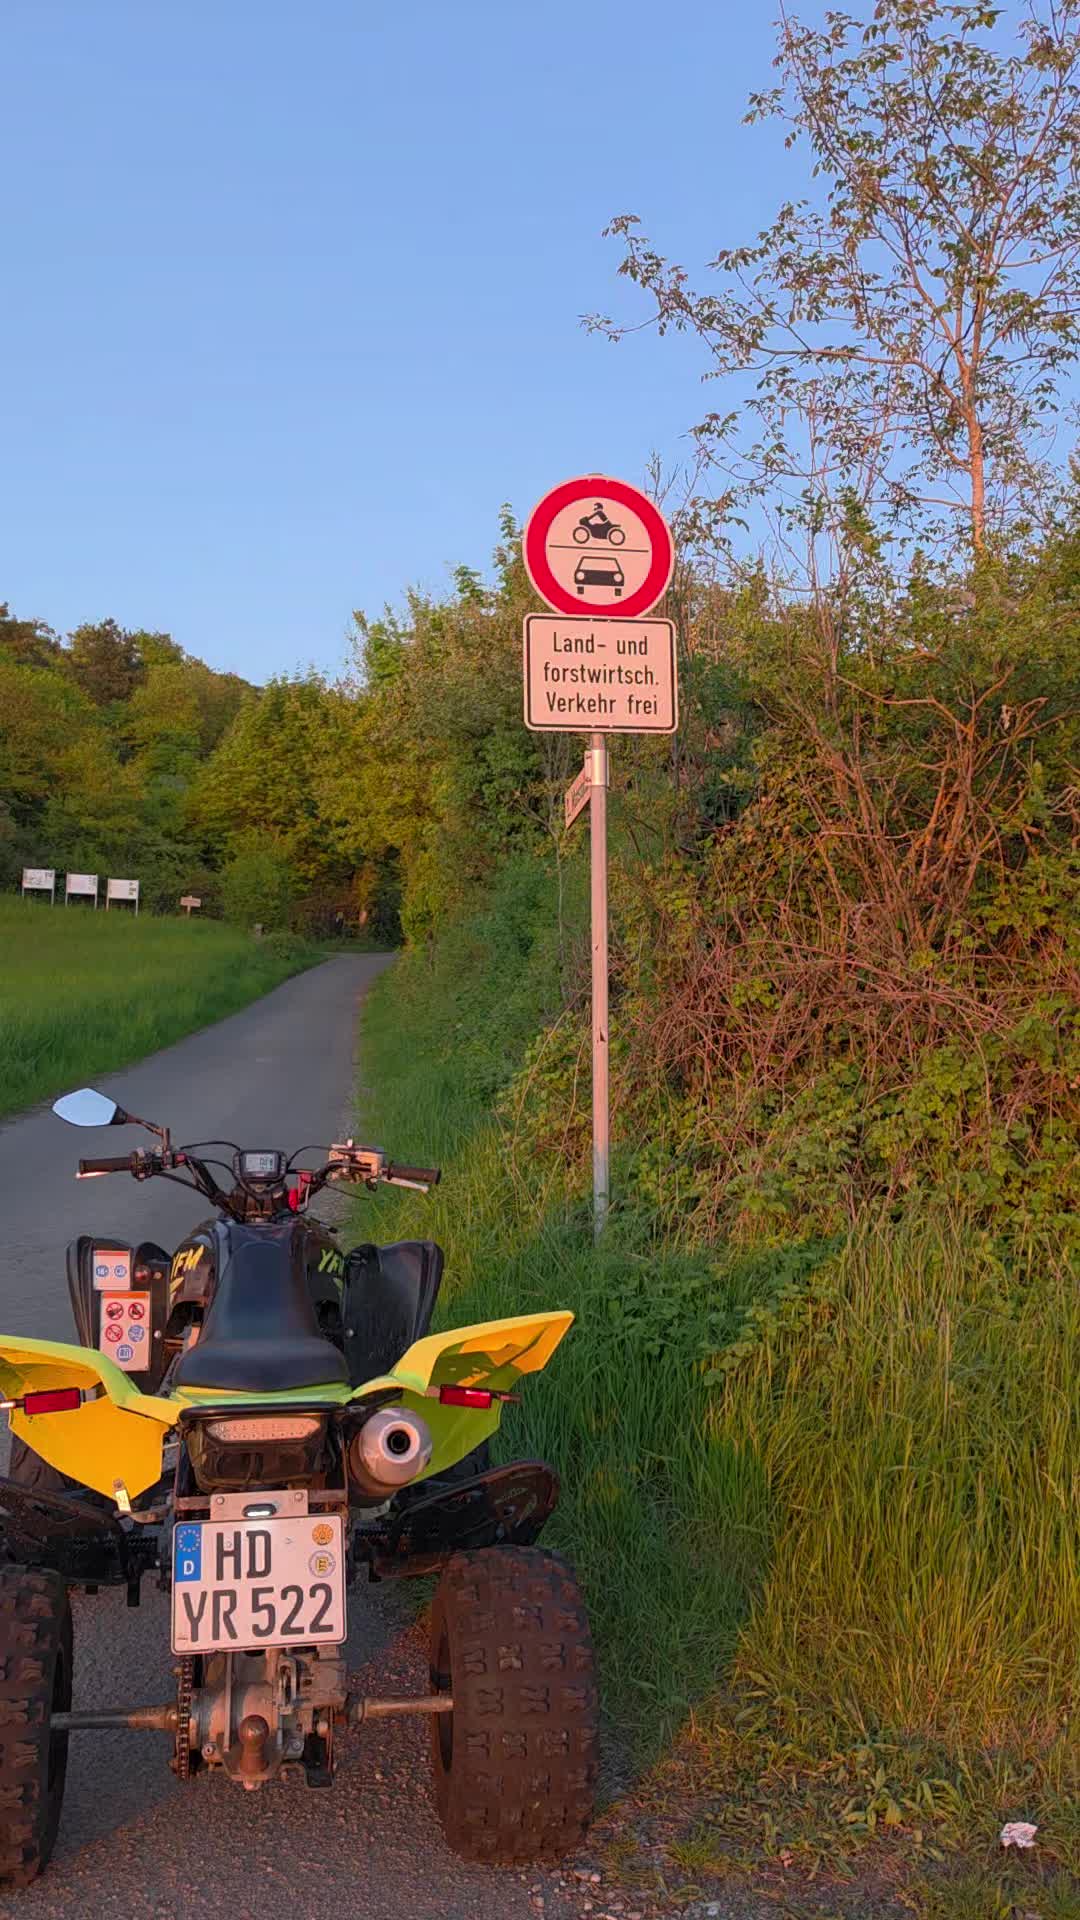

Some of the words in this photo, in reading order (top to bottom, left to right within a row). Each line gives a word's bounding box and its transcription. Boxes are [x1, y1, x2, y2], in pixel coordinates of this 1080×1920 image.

[554, 632, 606, 653] Land-
[616, 636, 648, 655] und
[544, 662, 659, 685] forstwirtsch.
[546, 691, 616, 713] Verkehr
[627, 694, 657, 714] frei
[216, 1530, 272, 1581] HD
[183, 1560, 195, 1575] D
[182, 1589, 238, 1643] YR
[251, 1583, 334, 1638] 522
